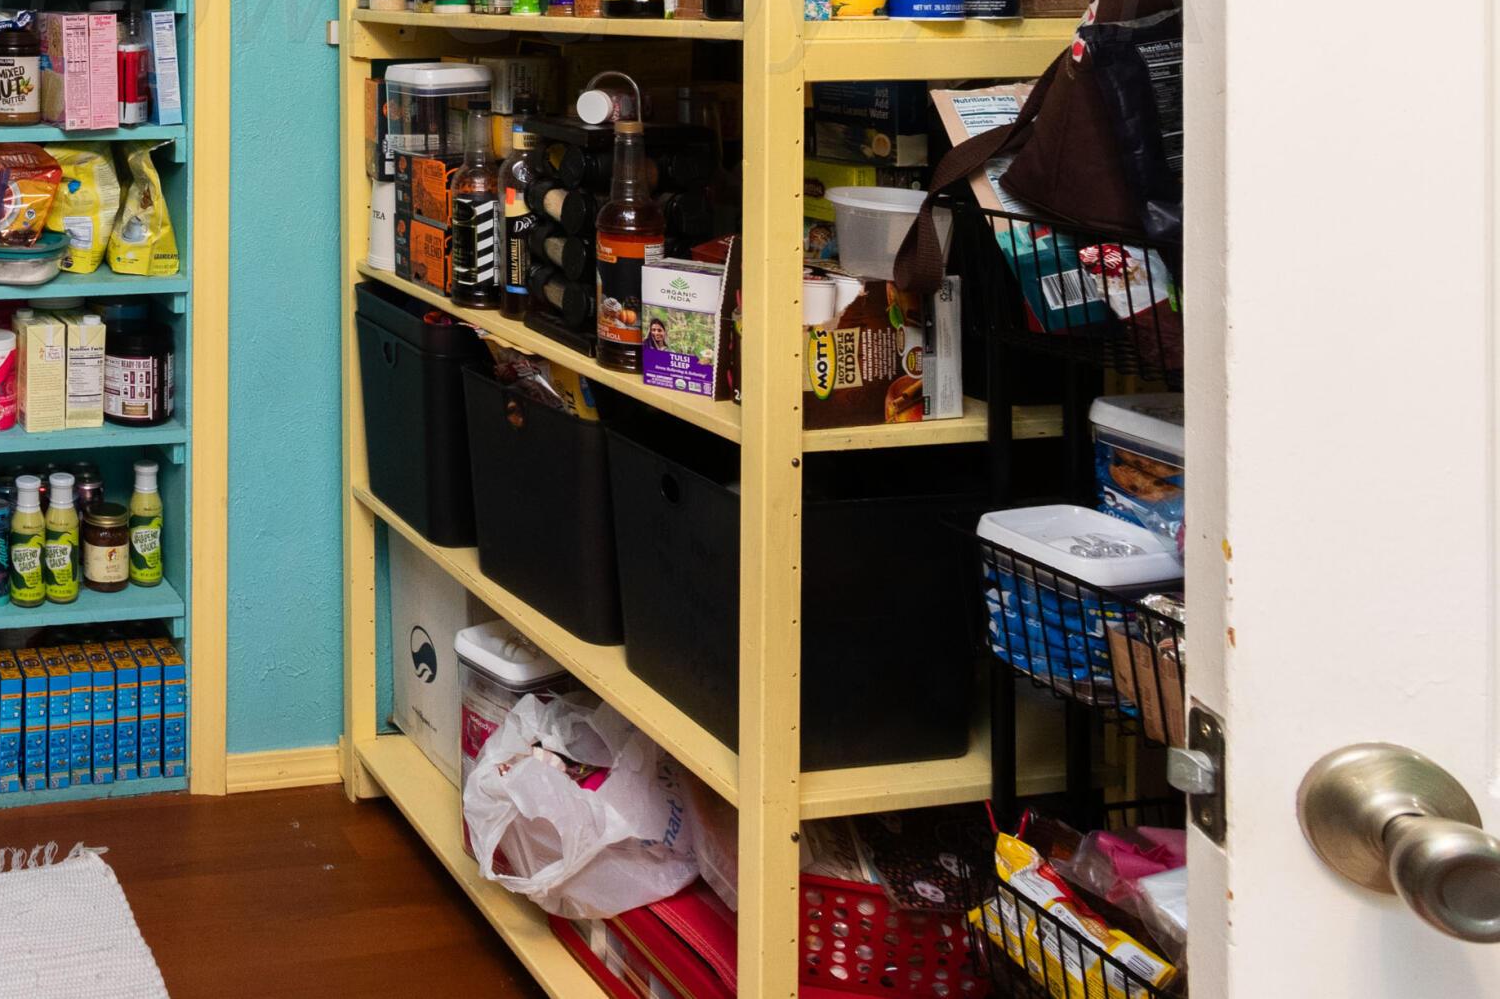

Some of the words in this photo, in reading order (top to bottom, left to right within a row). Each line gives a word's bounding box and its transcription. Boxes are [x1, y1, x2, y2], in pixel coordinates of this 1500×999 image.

[1138, 45, 1168, 54] Nutrition
[2, 94, 27, 104] BUTTER
[953, 96, 989, 106] Nutrition
[992, 94, 1016, 104] Facts
[964, 117, 994, 125] Calories
[372, 210, 386, 221] TEA
[660, 288, 697, 299] ORGANIC
[667, 295, 691, 303] INDIA
[606, 333, 621, 341] ROLL
[837, 332, 845, 367] APPLE
[669, 353, 690, 362] TULSI
[816, 329, 829, 390] MOTT'S
[845, 331, 856, 385] CIDER
[670, 361, 690, 369] SLEEP
[837, 369, 845, 385] HOT
[139, 541, 156, 553] SAUCE
[19, 559, 36, 570] SAUCE
[50, 557, 67, 568] SAUCE
